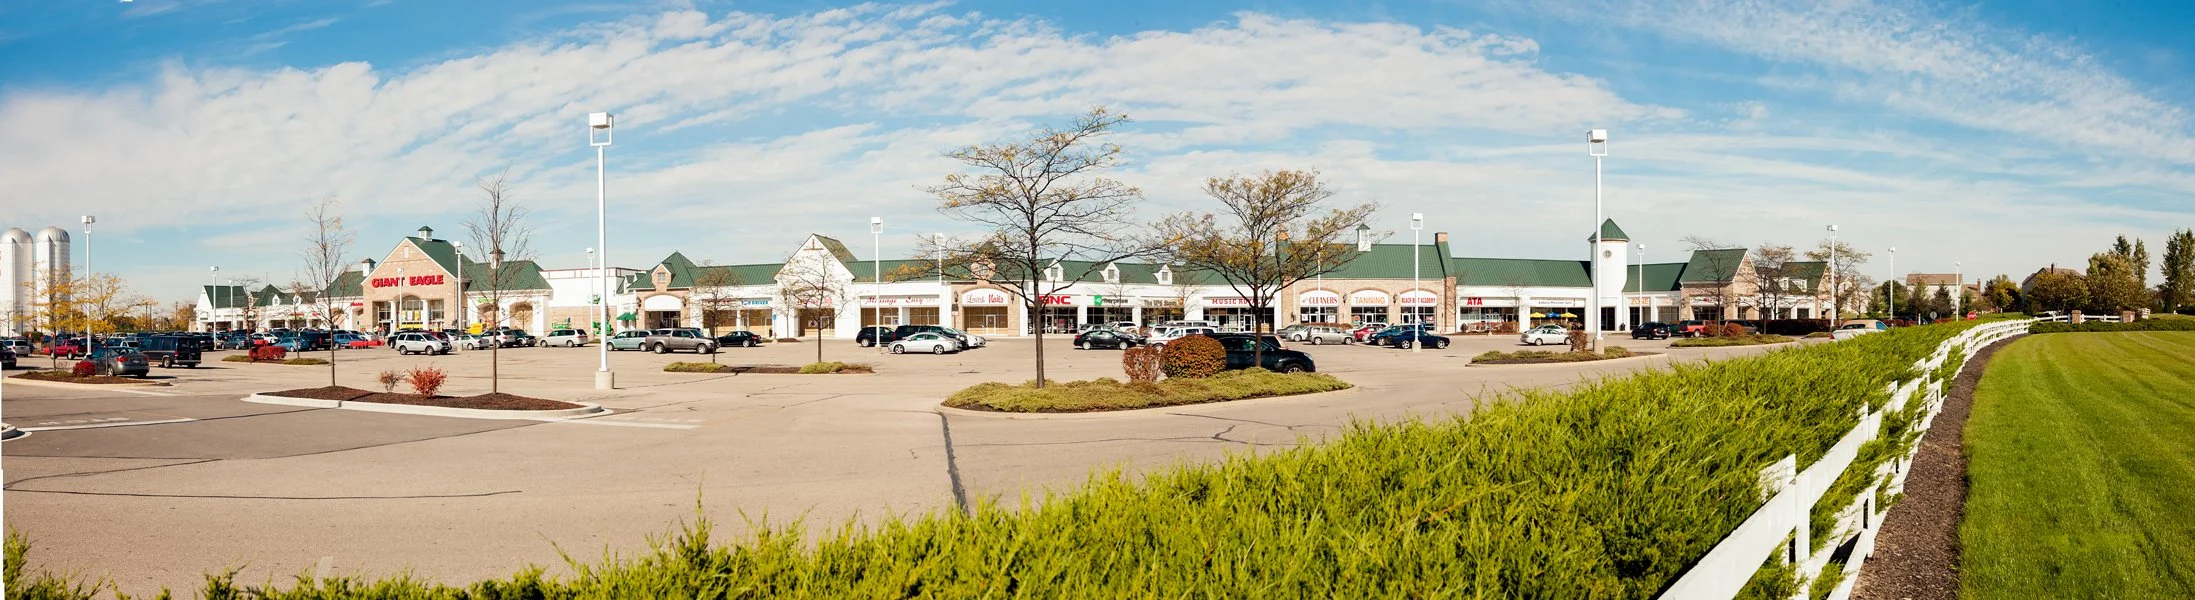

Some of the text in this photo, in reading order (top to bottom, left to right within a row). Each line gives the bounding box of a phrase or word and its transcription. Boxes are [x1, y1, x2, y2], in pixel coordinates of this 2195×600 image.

[372, 274, 444, 288] GIANT EAGLE
[1308, 296, 1338, 304] CLEANERS
[1355, 296, 1385, 304] TANNING
[1467, 297, 1483, 306] ATA
